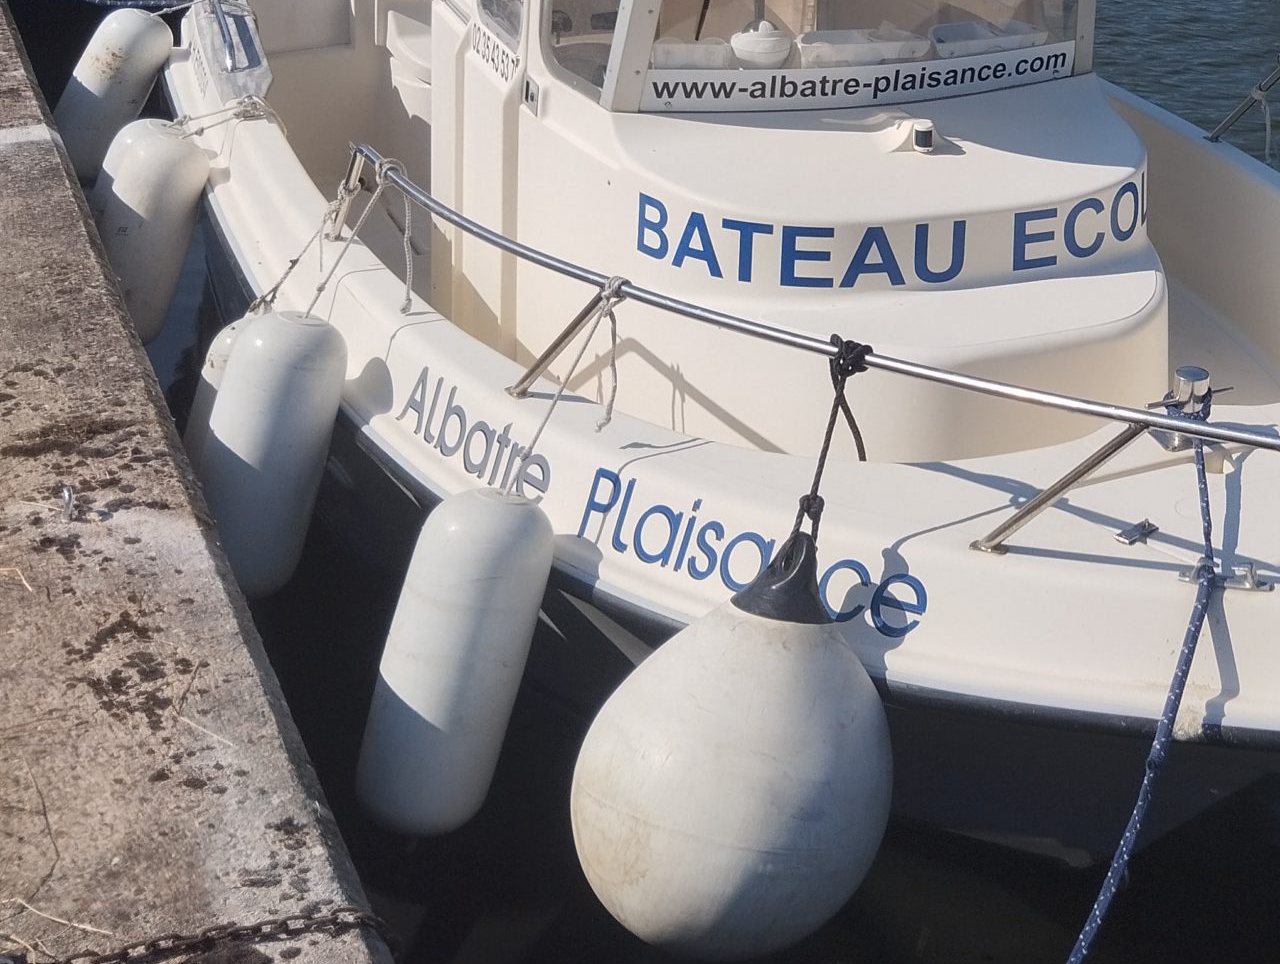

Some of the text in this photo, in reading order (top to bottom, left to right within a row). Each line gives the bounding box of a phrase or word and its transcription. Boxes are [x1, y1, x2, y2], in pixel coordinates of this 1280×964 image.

[652, 49, 1067, 99] www-albatre-plaisance.com
[637, 191, 966, 288] BATEAU
[396, 366, 928, 638] Albatre Plaisace
